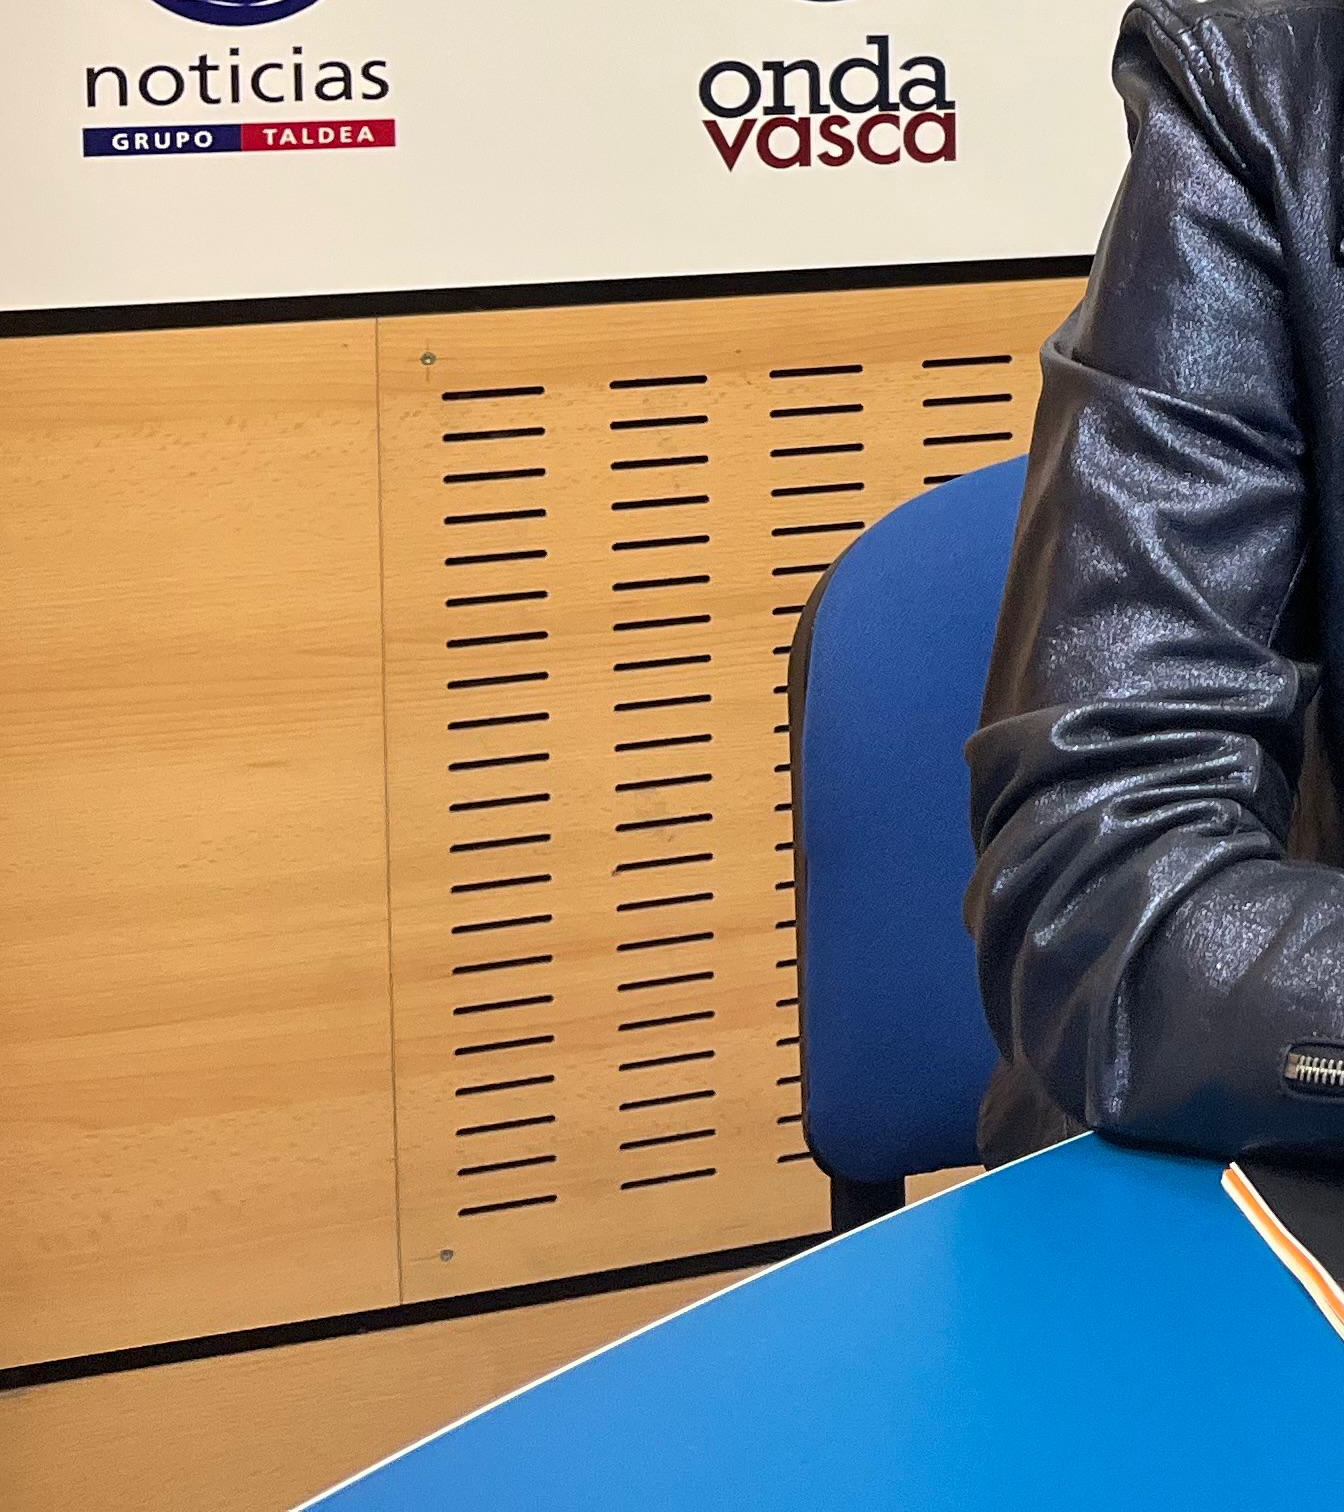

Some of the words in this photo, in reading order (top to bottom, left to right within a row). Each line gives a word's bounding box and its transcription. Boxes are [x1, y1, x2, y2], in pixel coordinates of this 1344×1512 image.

[86, 46, 389, 108] noticias
[698, 34, 955, 118] onda
[111, 132, 213, 151] GRUPO
[262, 125, 375, 147] TALDEA
[702, 110, 956, 172] vasca
